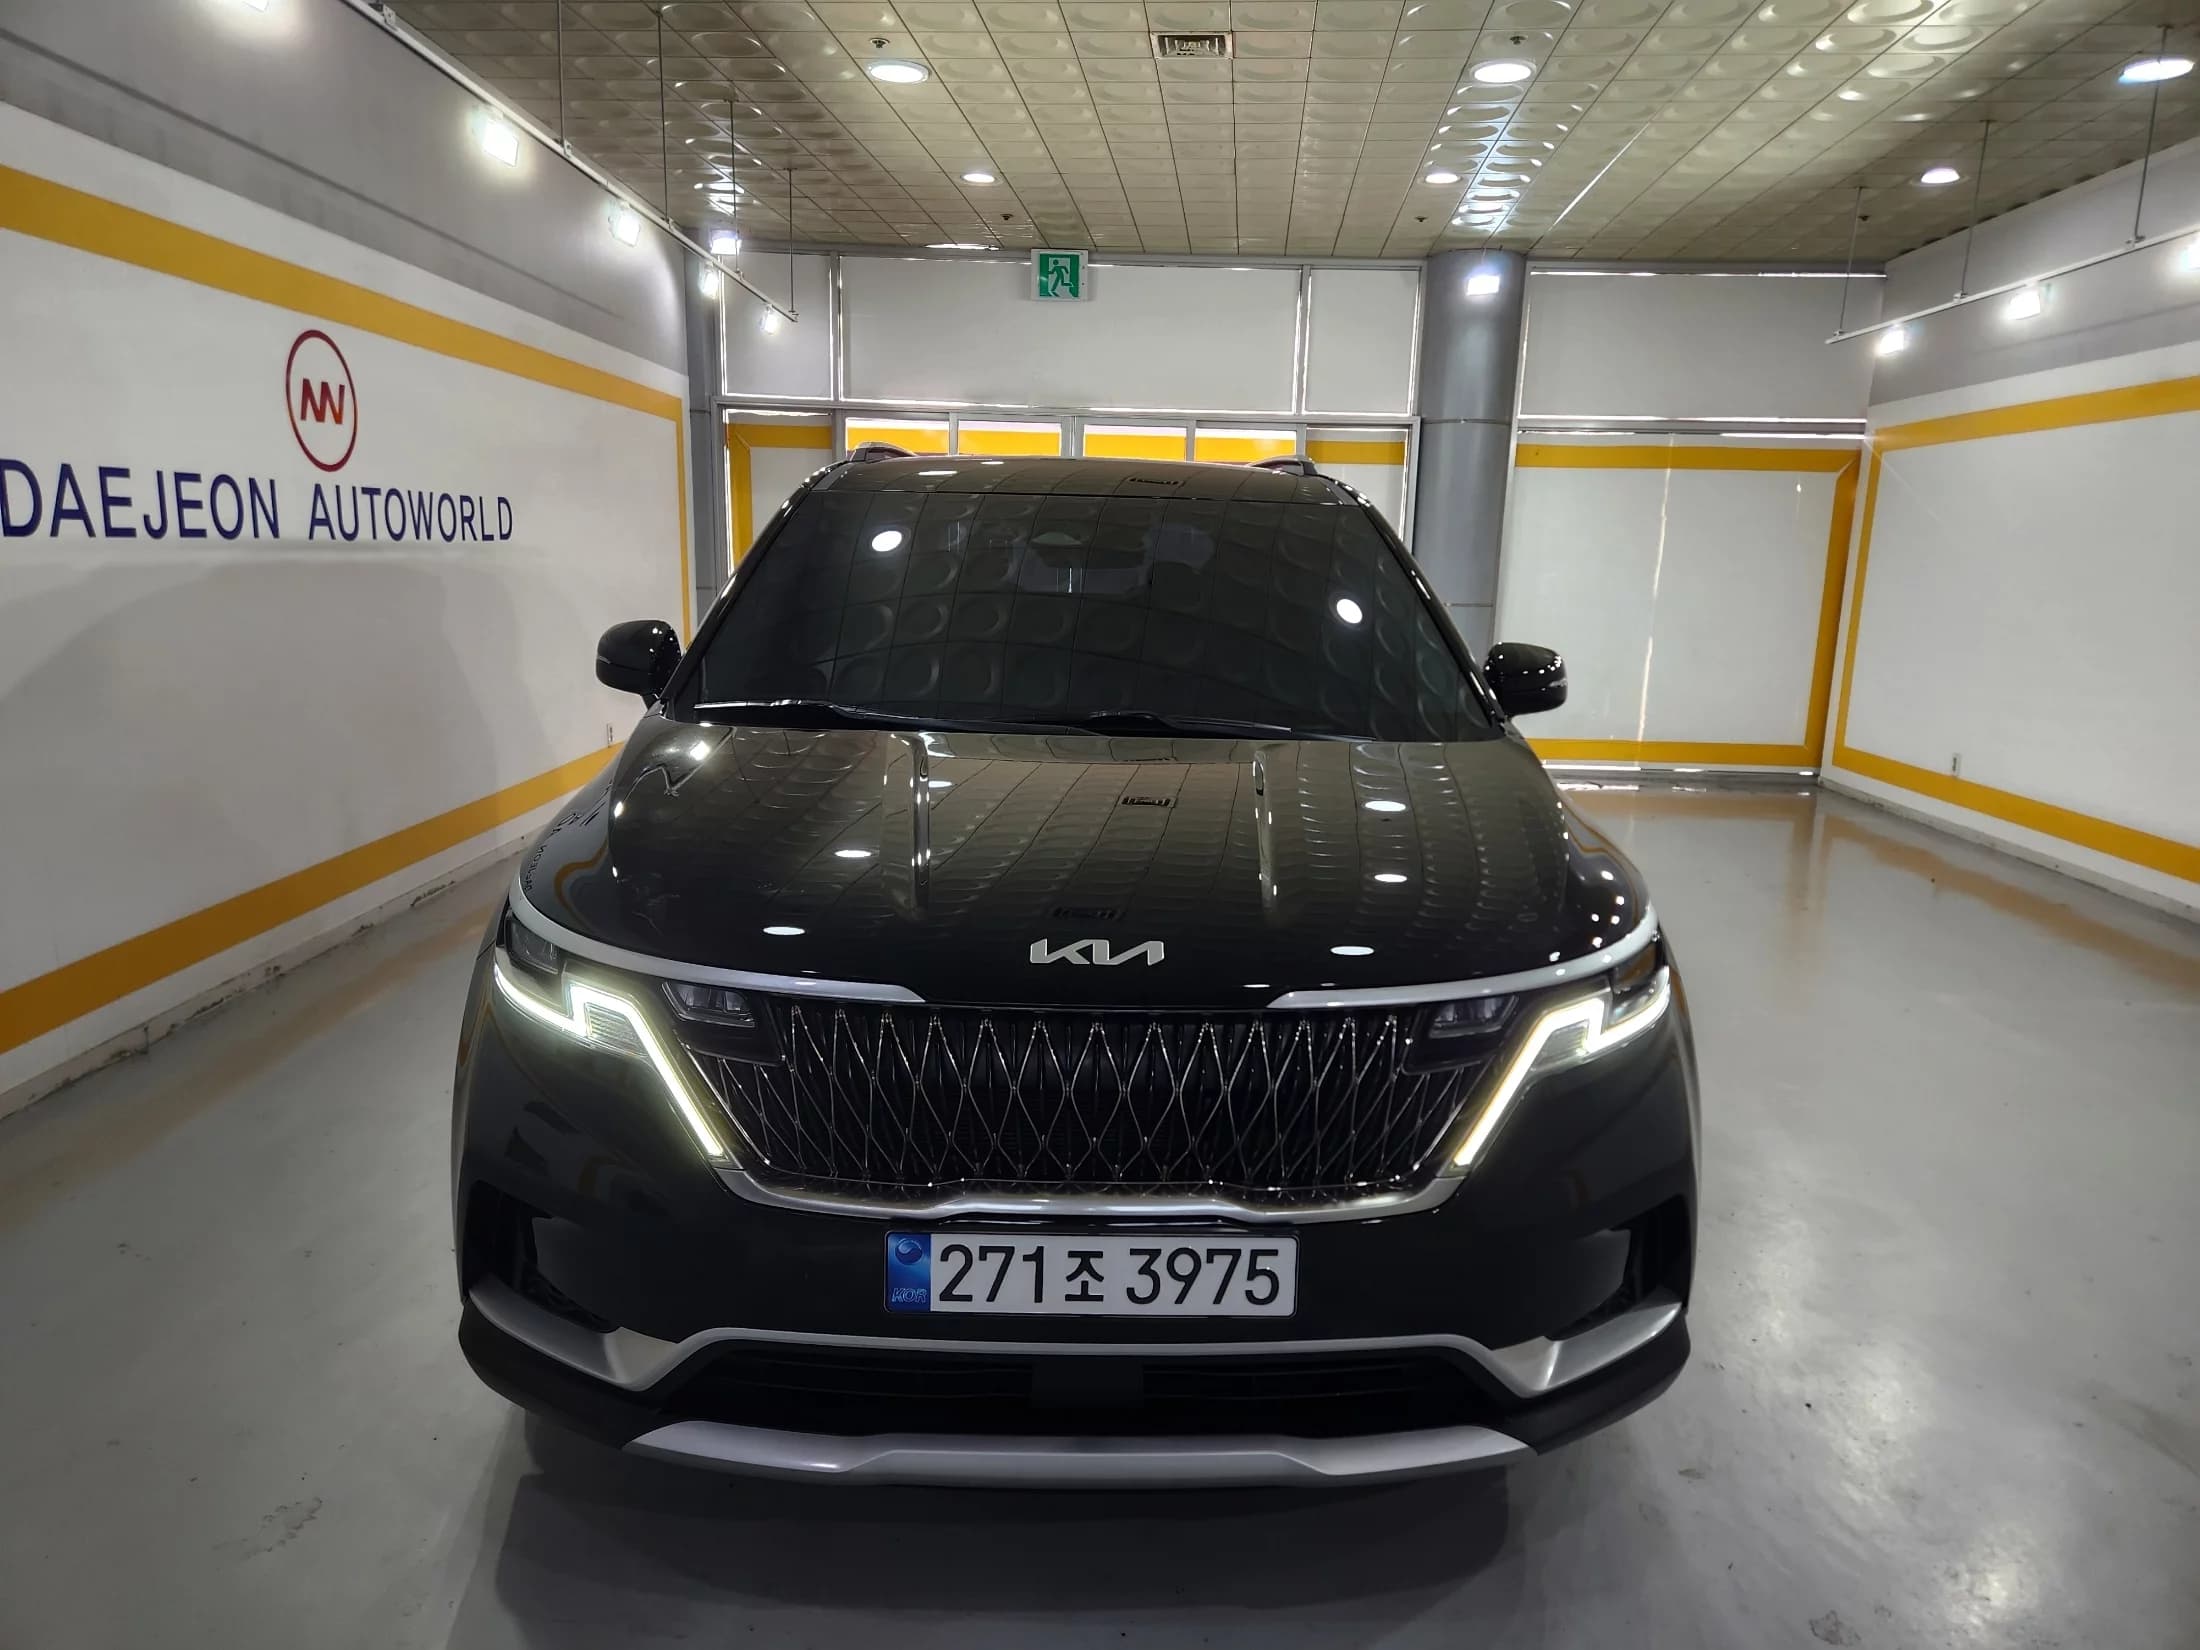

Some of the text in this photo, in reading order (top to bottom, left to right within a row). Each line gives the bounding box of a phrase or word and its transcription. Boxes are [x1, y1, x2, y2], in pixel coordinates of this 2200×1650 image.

[0, 458, 513, 541] DAEJEON AUTOWORLD
[891, 1287, 927, 1303] KOR
[938, 1245, 1280, 1306] 271조 3975
